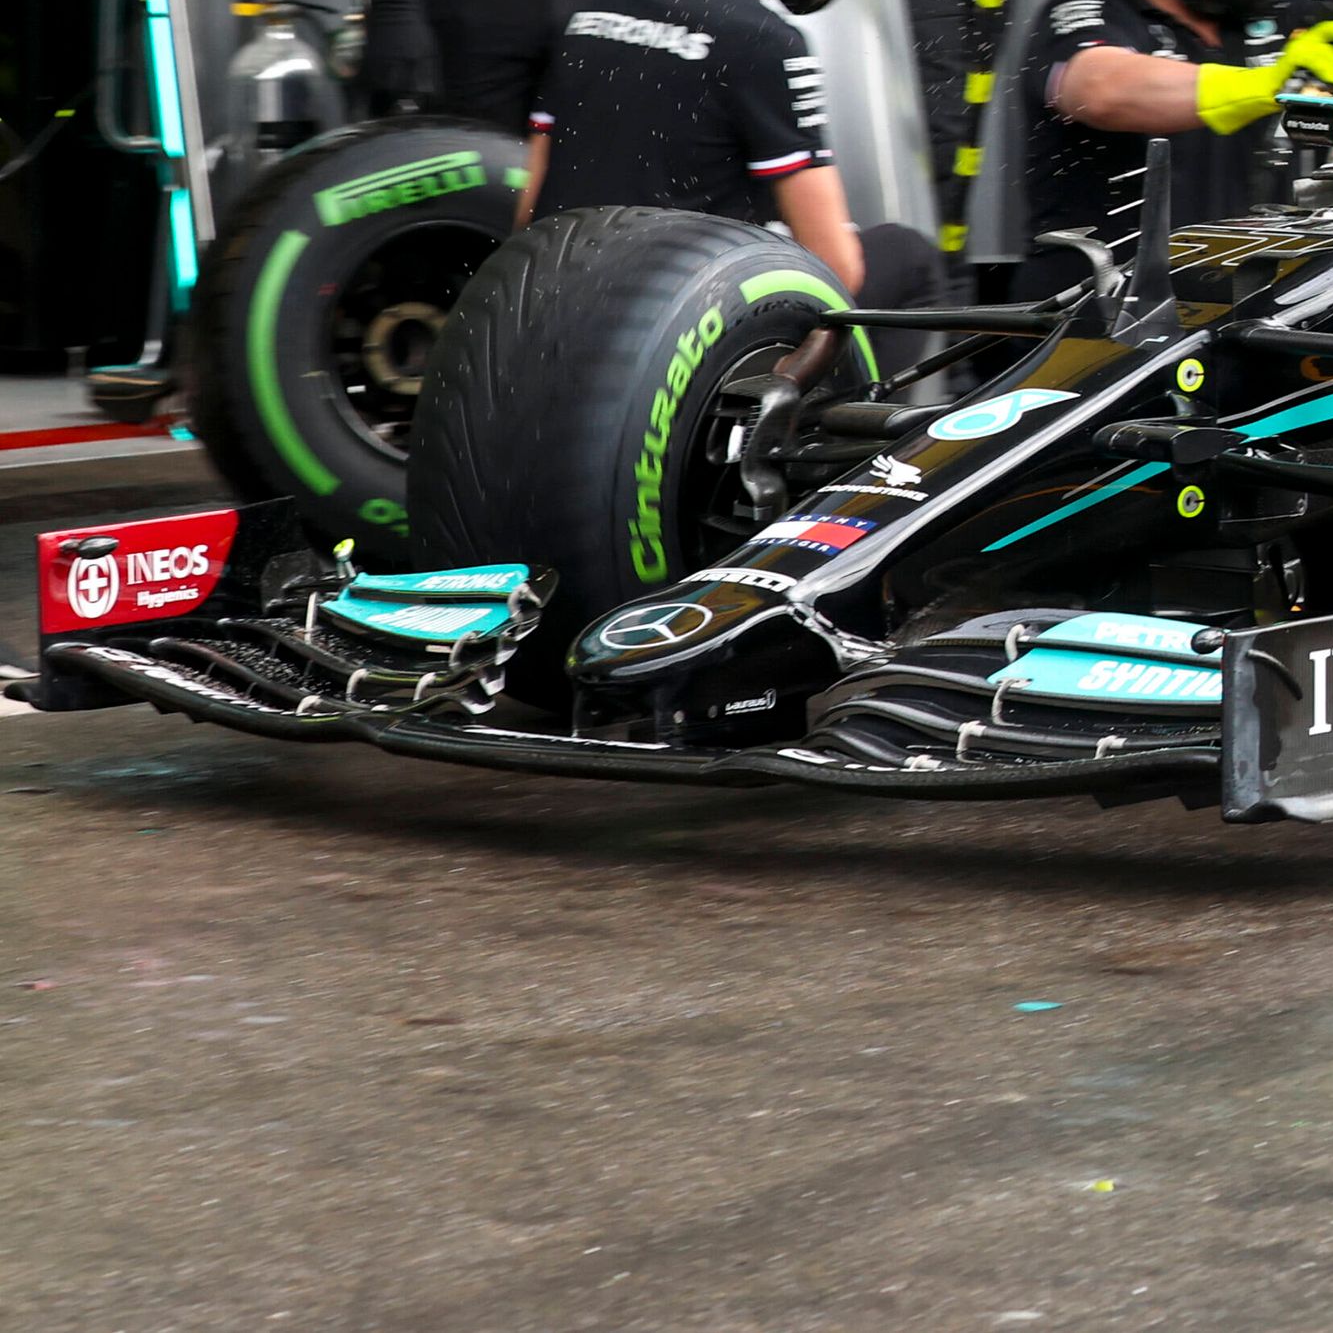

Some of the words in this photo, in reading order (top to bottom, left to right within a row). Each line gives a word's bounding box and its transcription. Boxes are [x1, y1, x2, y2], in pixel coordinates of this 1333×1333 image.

[564, 11, 715, 60] PETRONAS
[313, 150, 488, 227] PIRELLI
[627, 305, 725, 584] Cinturato
[816, 484, 930, 503] CROWDSTRIKE
[126, 544, 210, 586] INEOS
[1077, 660, 1223, 698] SYNTIU
